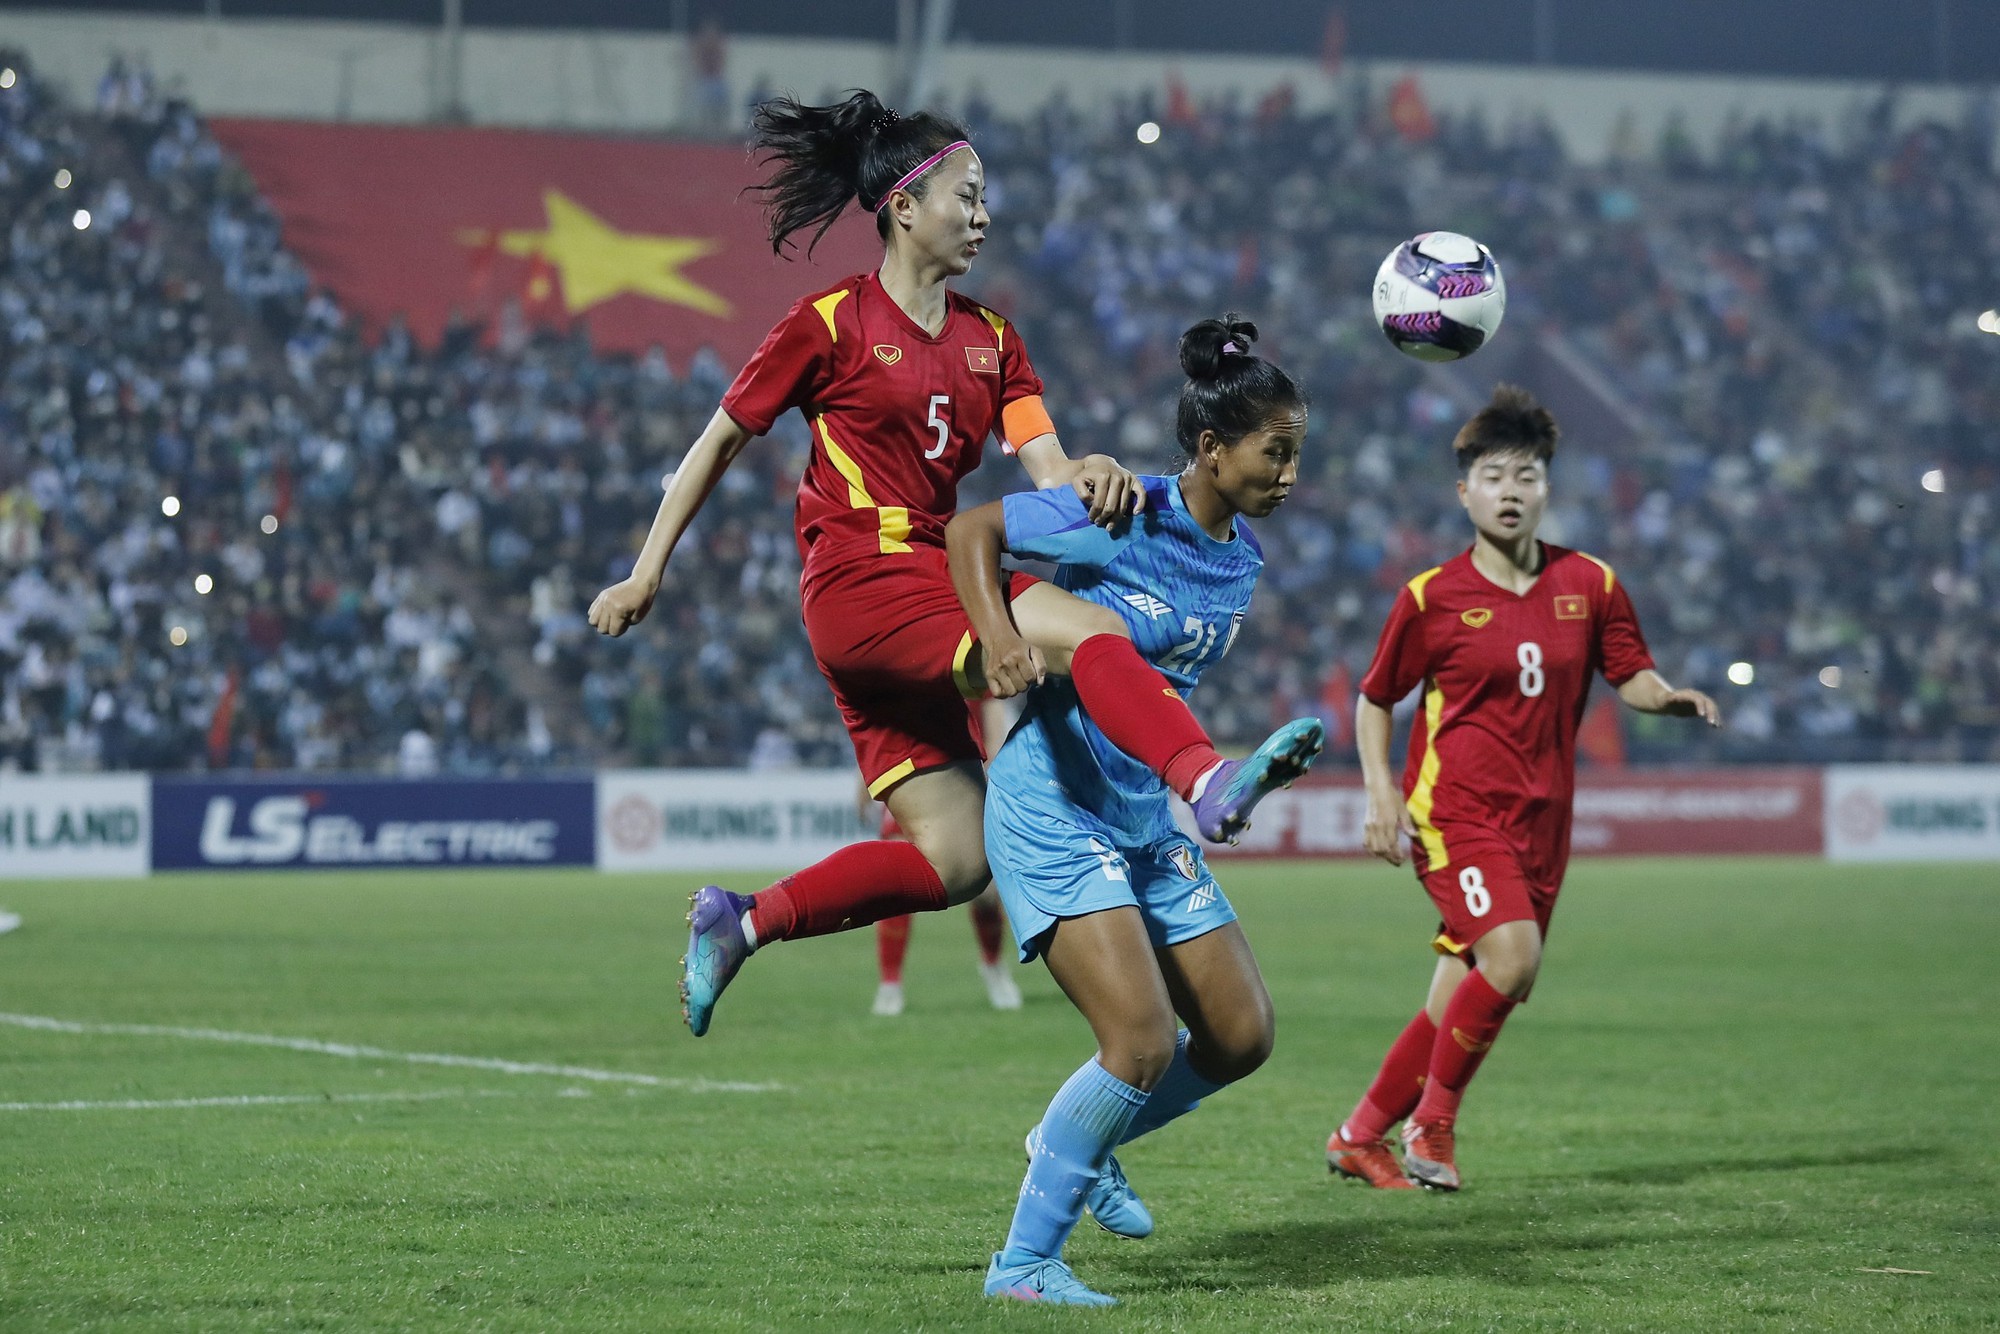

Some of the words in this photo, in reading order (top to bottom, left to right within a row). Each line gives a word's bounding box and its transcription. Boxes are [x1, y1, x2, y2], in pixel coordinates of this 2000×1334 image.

[924, 395, 950, 460] 5
[1156, 615, 1217, 676] 21
[1516, 641, 1545, 698] 8
[25, 806, 140, 848] LAND
[200, 794, 310, 863] LS
[305, 814, 560, 863] ELECTRIC
[1458, 865, 1492, 918] 8
